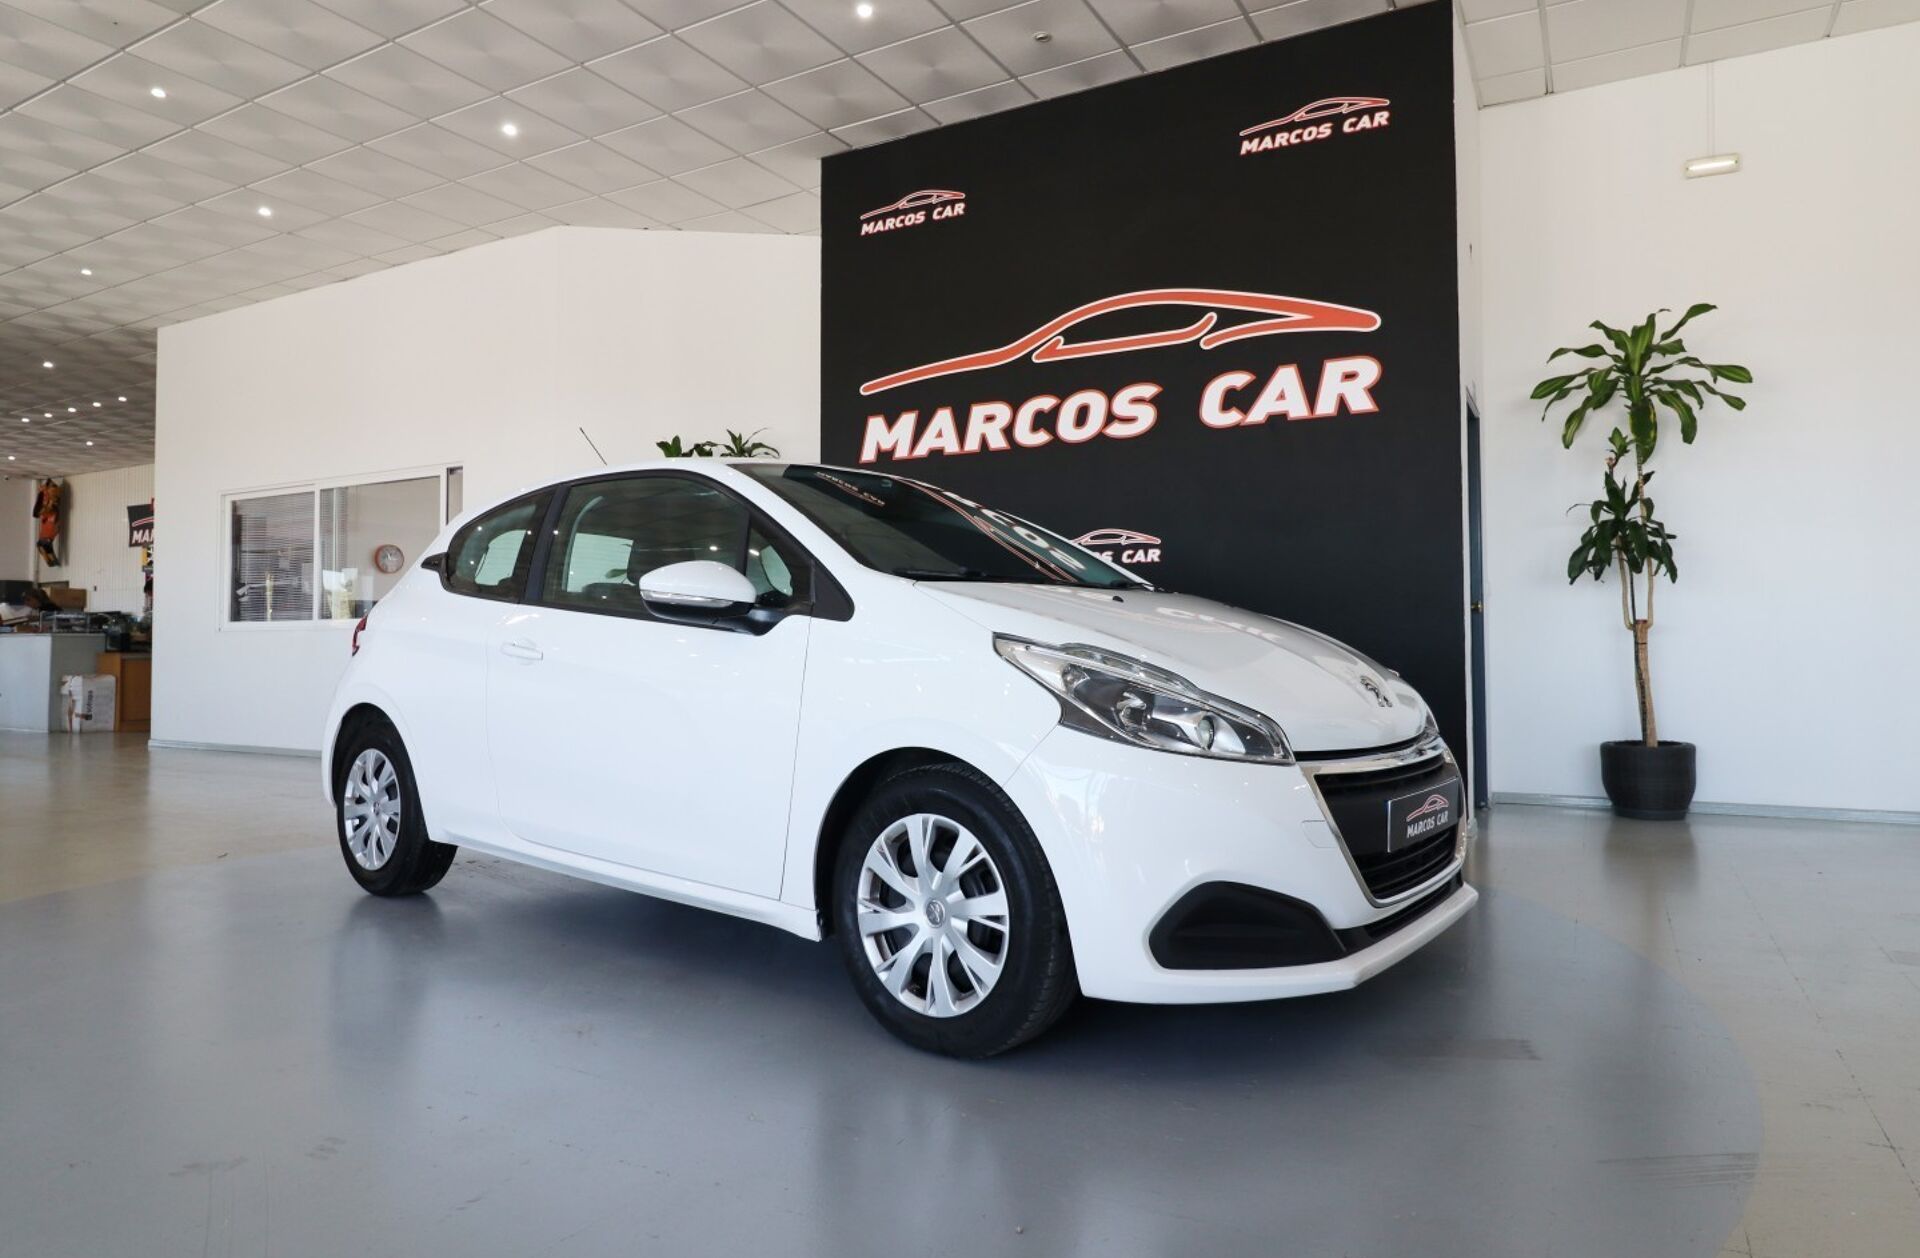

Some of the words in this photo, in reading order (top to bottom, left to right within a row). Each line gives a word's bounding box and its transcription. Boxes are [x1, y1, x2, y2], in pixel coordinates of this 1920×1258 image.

[1239, 122, 1334, 156] MARCOS
[1342, 110, 1390, 133] CAR
[860, 211, 926, 236] MARCOS
[932, 202, 966, 220] CAR
[859, 382, 1163, 463] MARCOS
[1200, 356, 1383, 428] CAR
[1121, 547, 1161, 564] CAR
[1406, 815, 1436, 839] MARCOS
[1436, 810, 1450, 826] CAR
